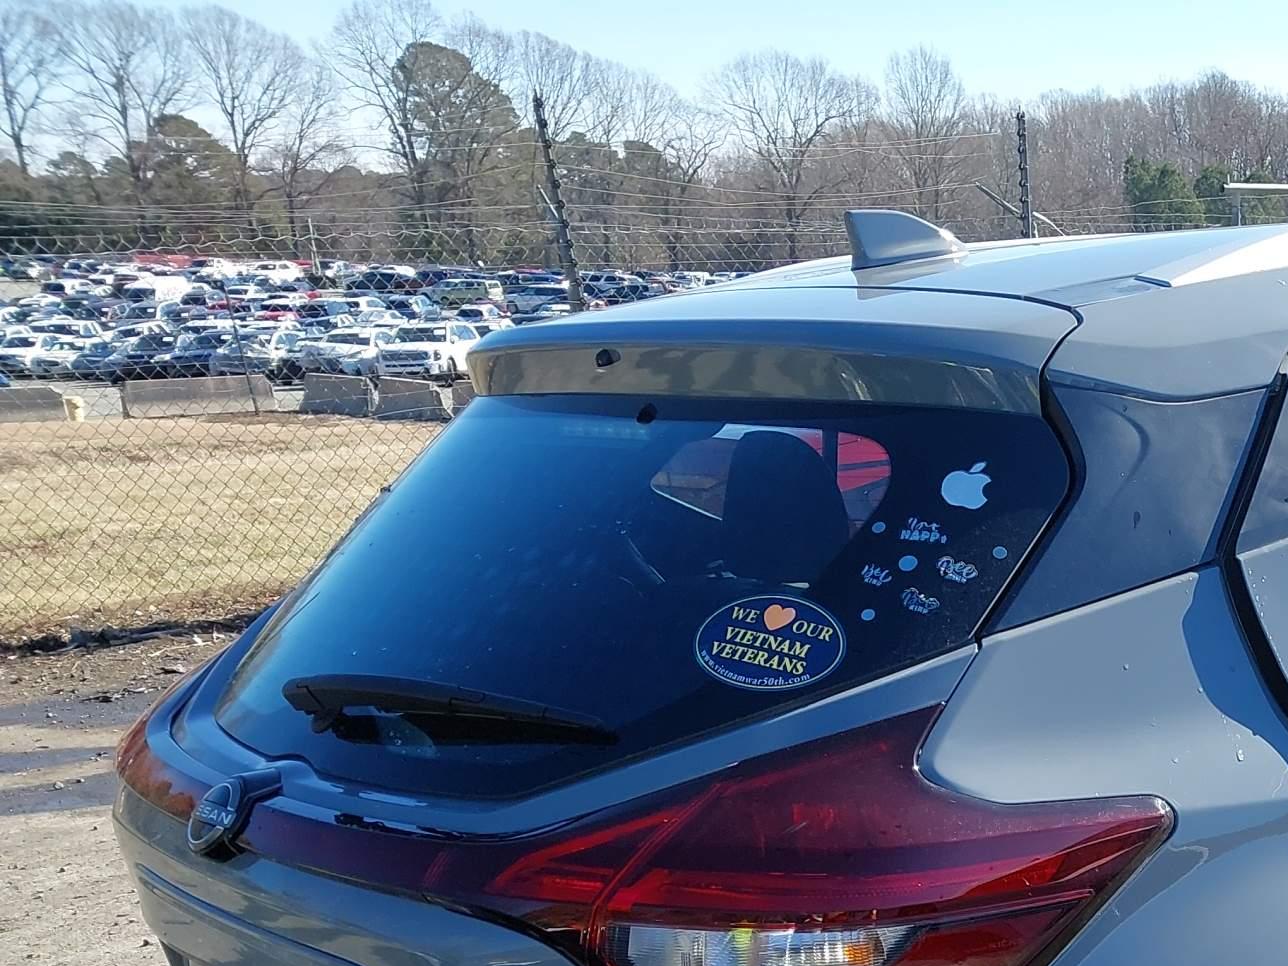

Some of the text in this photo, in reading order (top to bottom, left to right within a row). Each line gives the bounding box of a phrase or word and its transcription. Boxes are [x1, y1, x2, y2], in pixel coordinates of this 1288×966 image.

[731, 606, 834, 641] WE OUR
[711, 641, 807, 675] VETERANS
[725, 626, 811, 658] VIETNAM
[700, 649, 811, 686] www.vietnamwar50th.com
